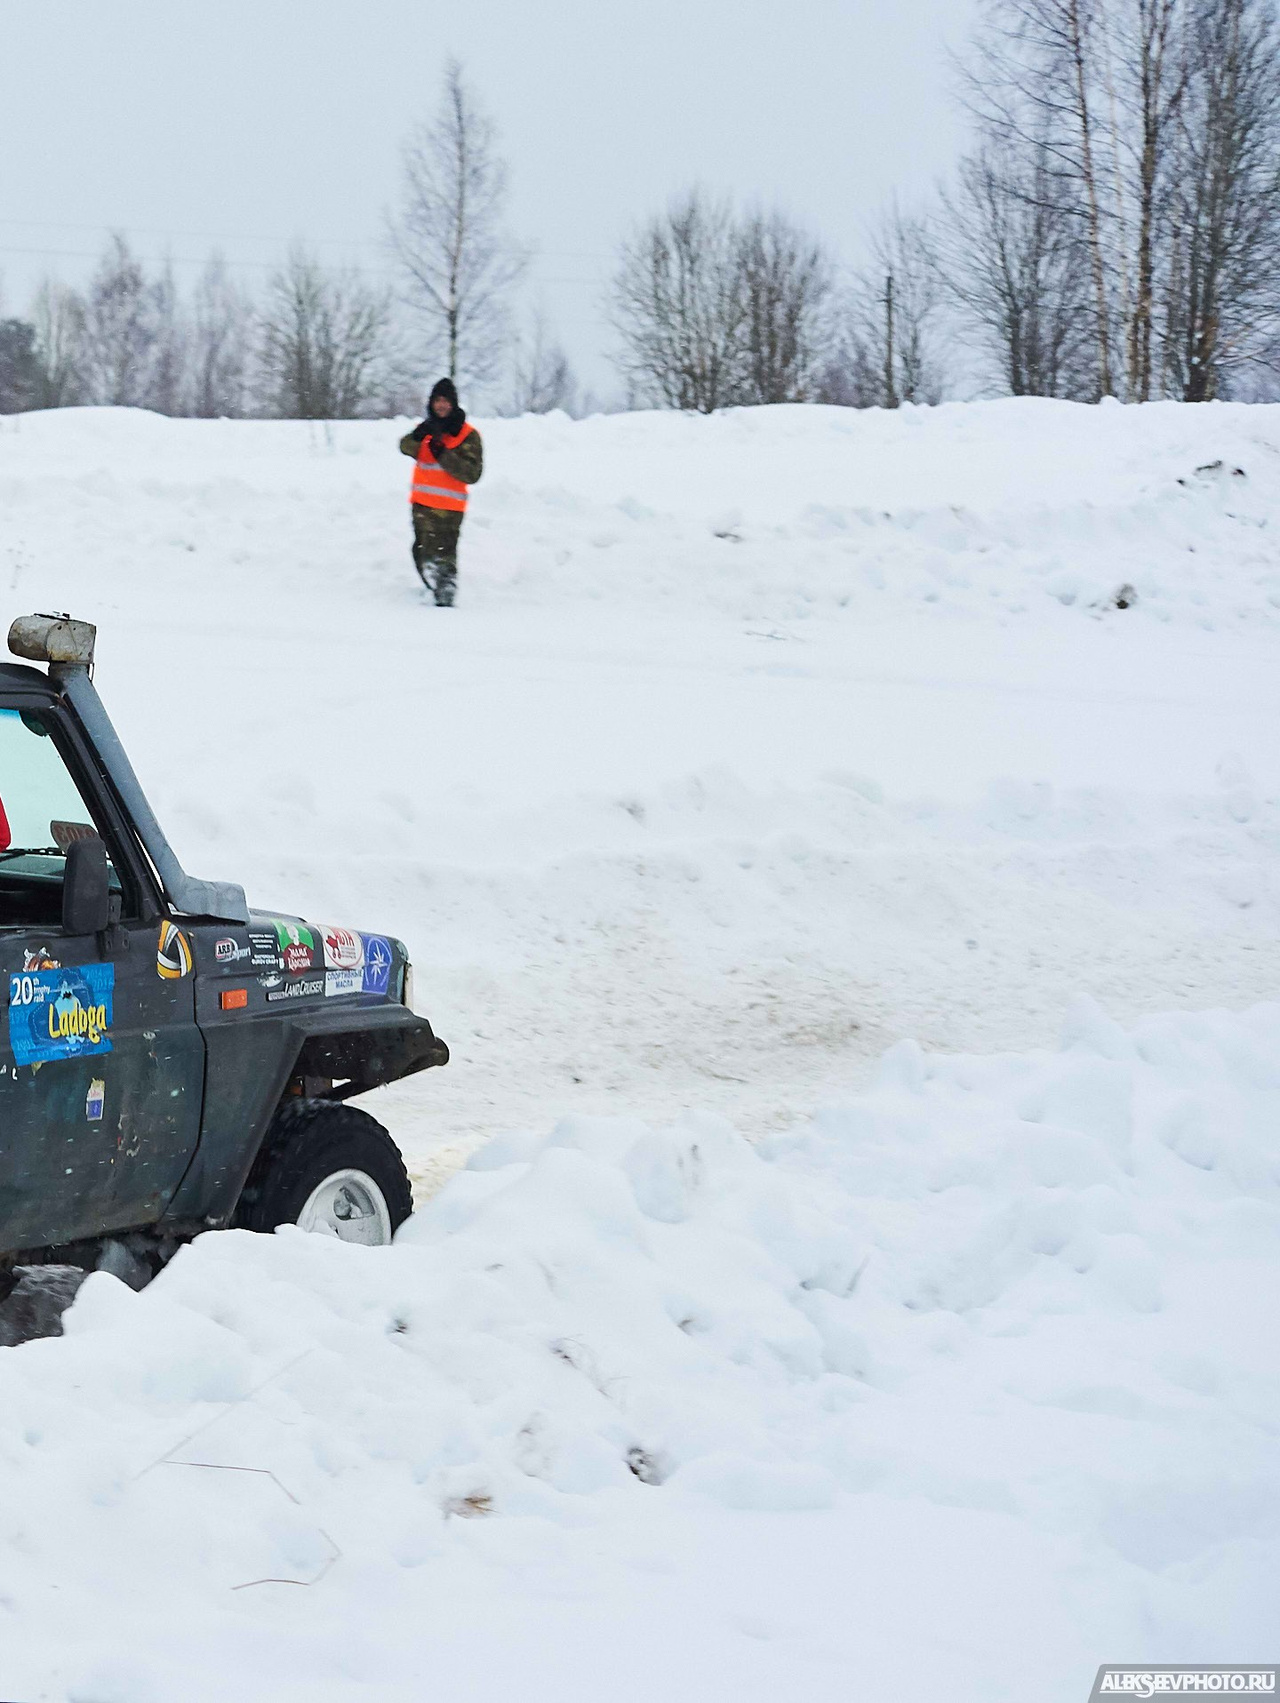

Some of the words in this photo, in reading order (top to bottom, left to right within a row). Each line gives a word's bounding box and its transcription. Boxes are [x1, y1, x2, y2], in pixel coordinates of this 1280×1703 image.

[217, 944, 231, 955] ARB
[327, 969, 363, 981] СПОРТИВНЫЕ
[335, 979, 353, 989] МАСЛА
[11, 976, 33, 1006] 20
[33, 993, 45, 1003] raid
[49, 1001, 107, 1044] Ladoga
